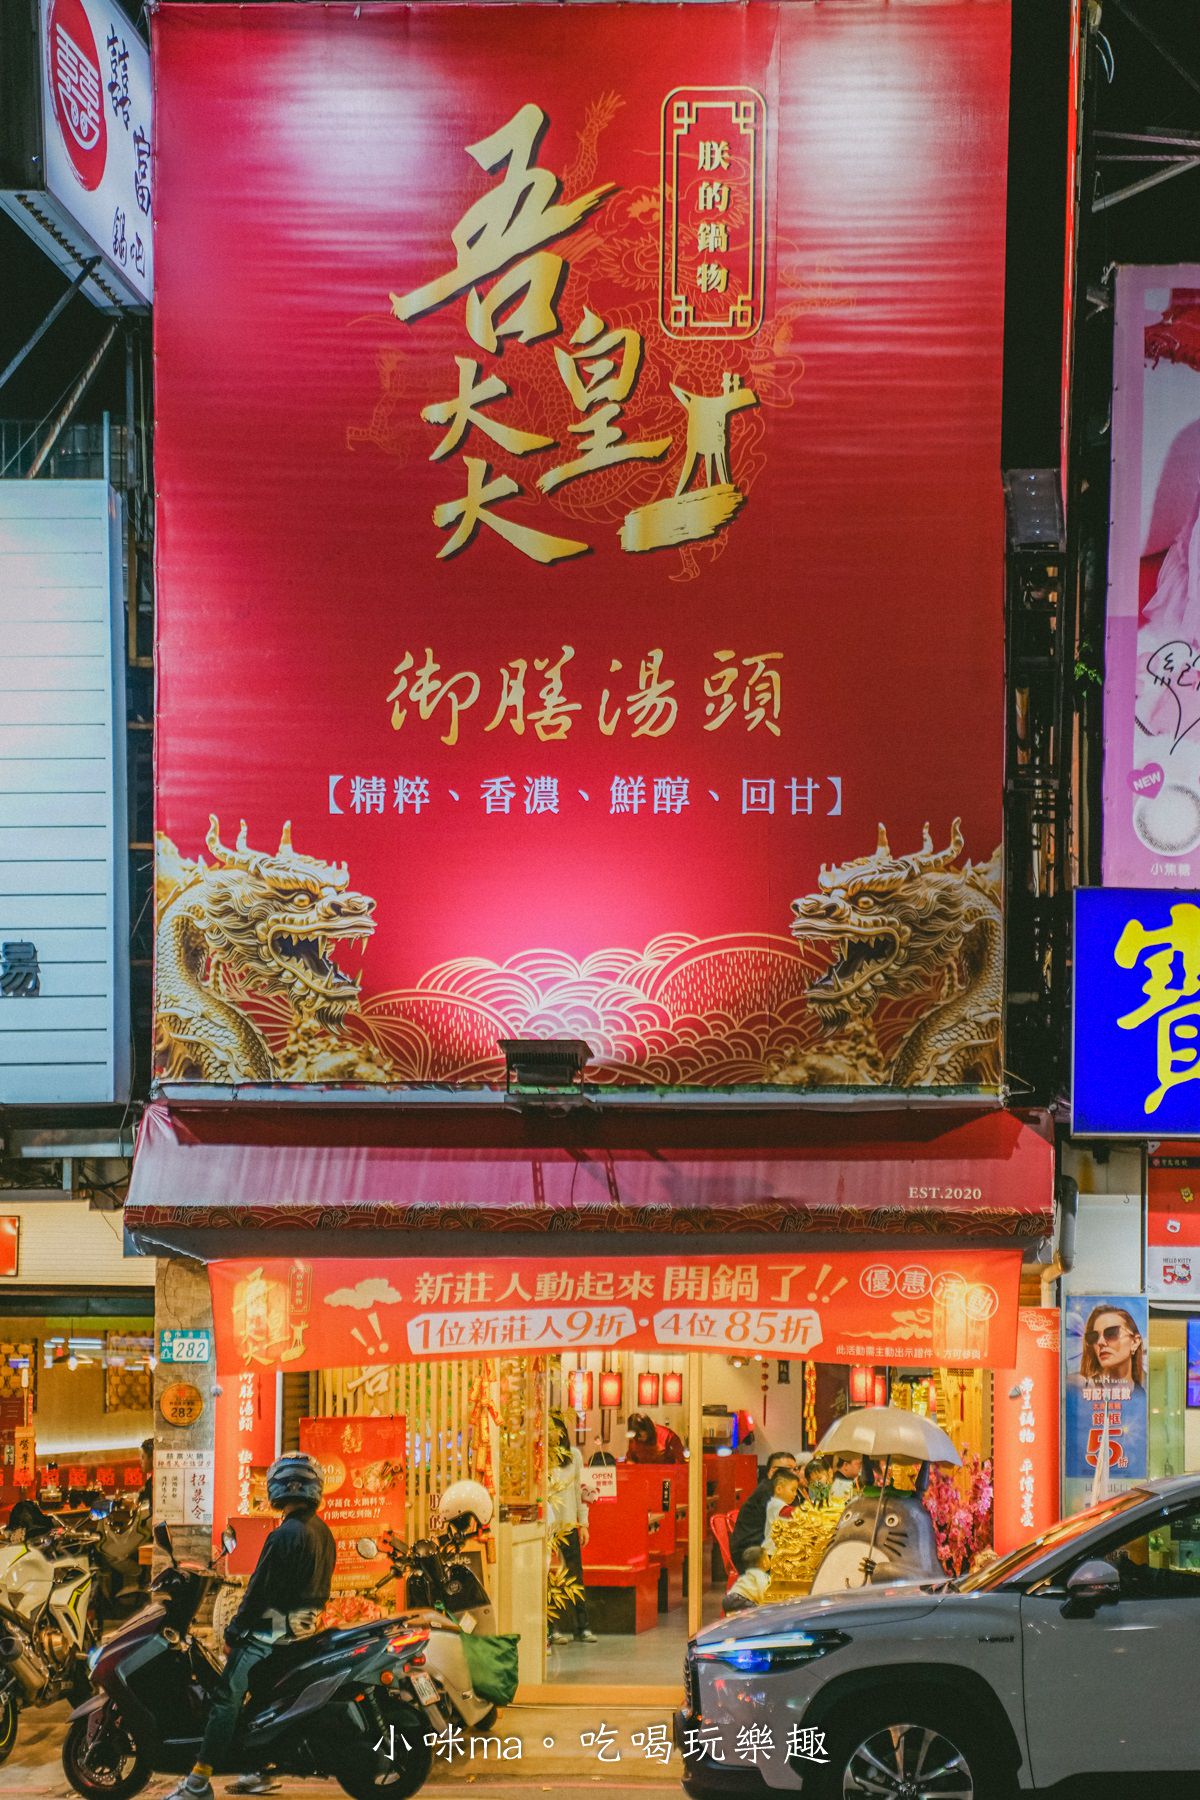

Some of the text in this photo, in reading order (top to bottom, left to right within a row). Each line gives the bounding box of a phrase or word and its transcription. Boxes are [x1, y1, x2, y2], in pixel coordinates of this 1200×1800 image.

[696, 140, 730, 294] 朕的鍋物
[385, 645, 784, 746] 御膳湯頭
[1133, 772, 1161, 791] NEW
[1150, 862, 1191, 877] 小焦糖
[908, 1187, 982, 1200] EST.2020
[413, 1270, 656, 1305] 新莊人動起來
[866, 1269, 993, 1318] 優惠活動
[176, 1342, 206, 1359] 282
[171, 1407, 193, 1418] 282
[592, 1472, 613, 1480] OPEN
[191, 1473, 206, 1520] 招募令
